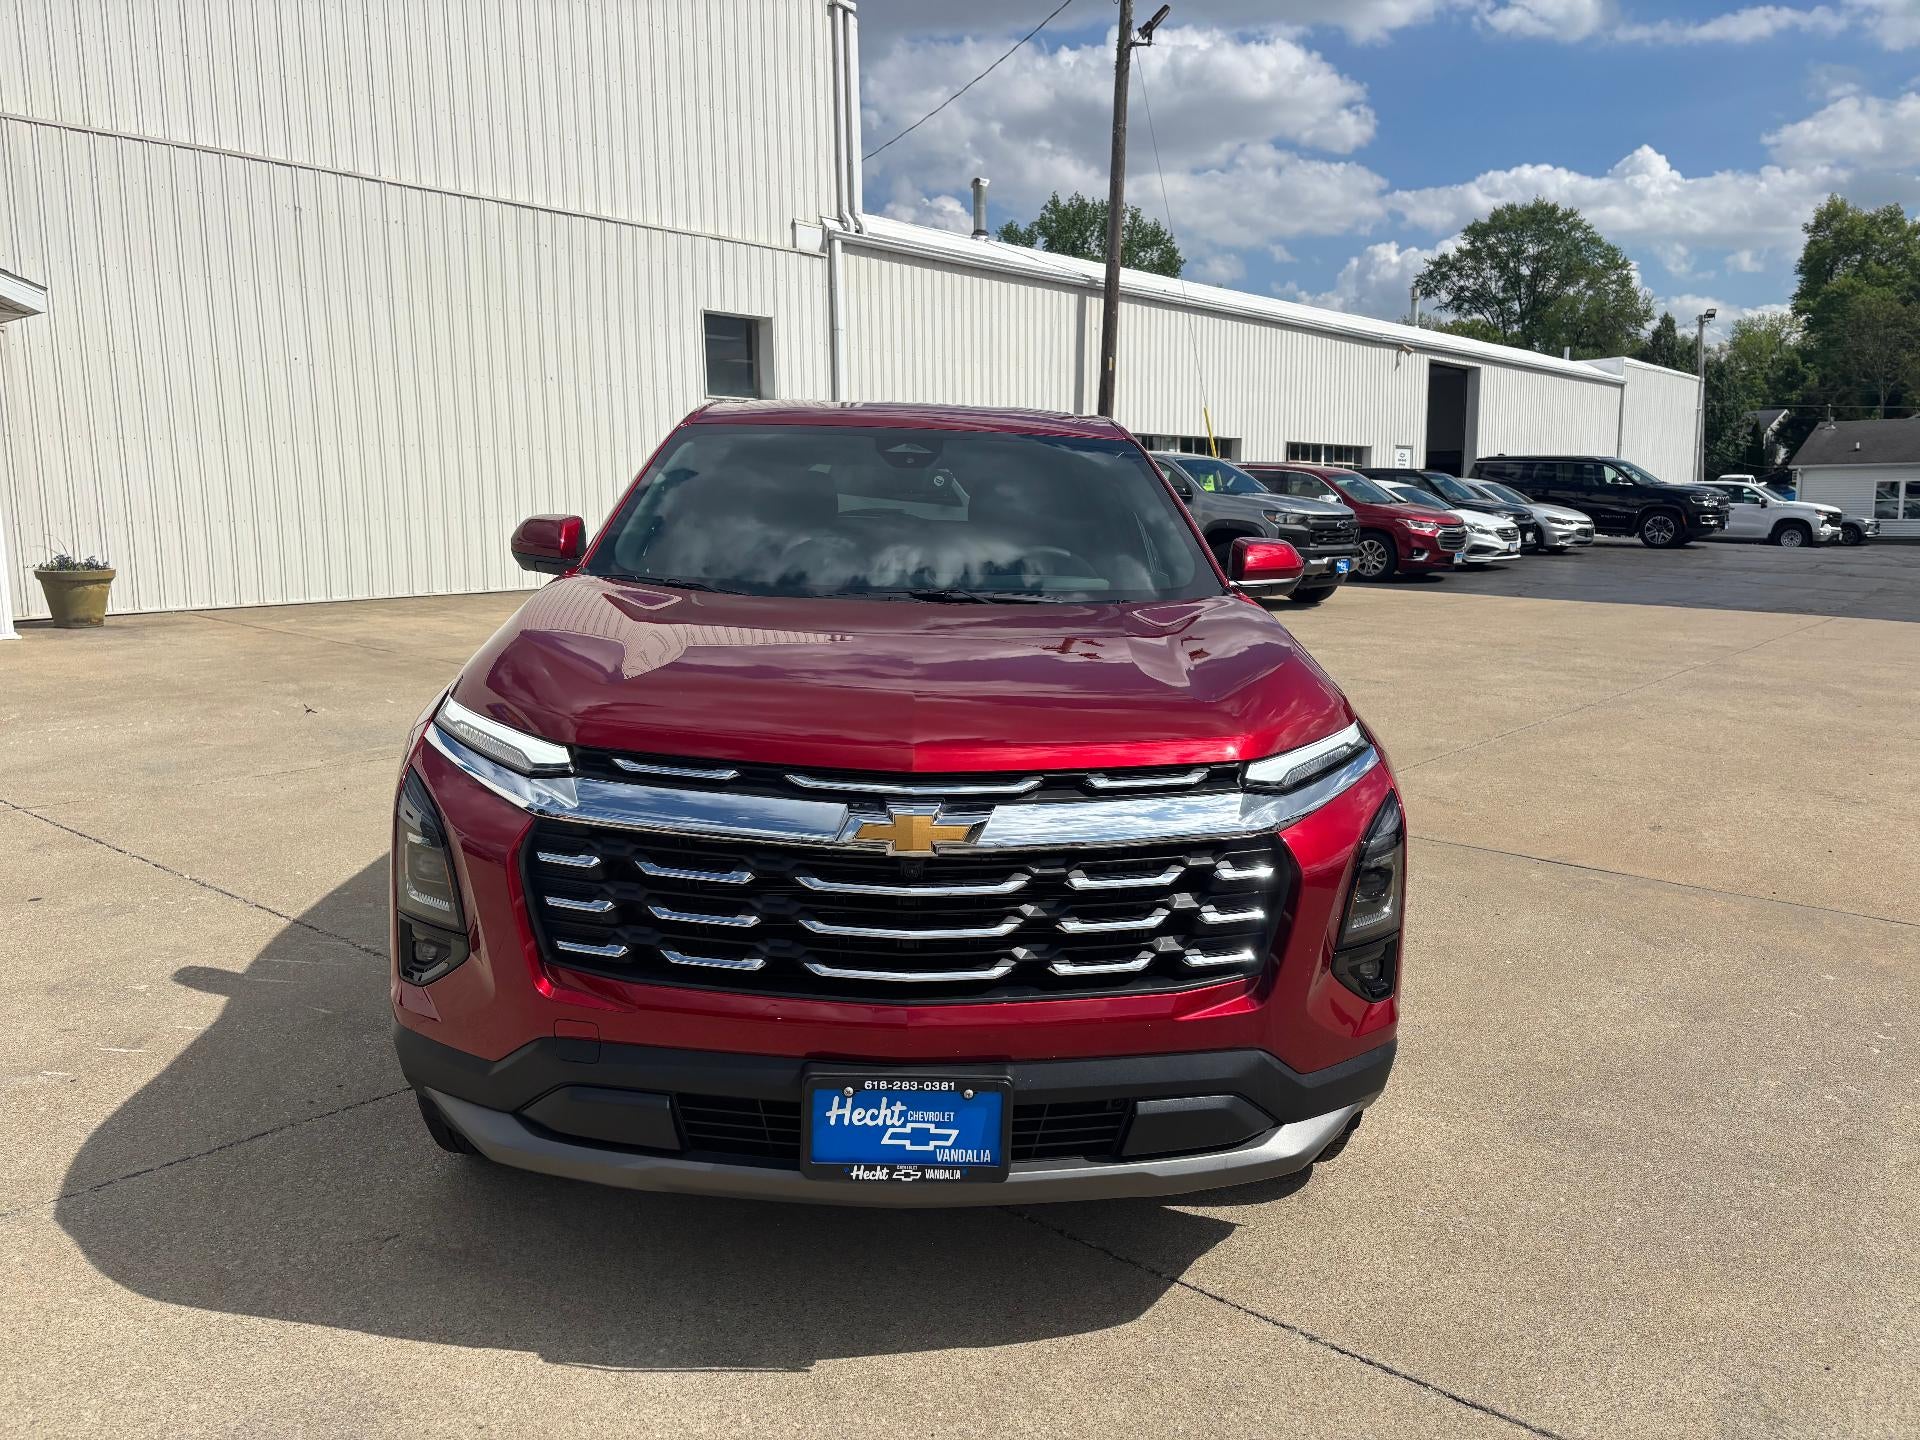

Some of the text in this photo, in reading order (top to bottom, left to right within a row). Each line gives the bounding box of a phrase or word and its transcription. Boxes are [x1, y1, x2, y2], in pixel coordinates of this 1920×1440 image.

[864, 1080, 955, 1091] 618-283-0381
[826, 1096, 954, 1126] Hecht CHEVROLET
[936, 1149, 991, 1163] VANDALIA
[850, 1165, 961, 1180] Hecht VANDALIA
